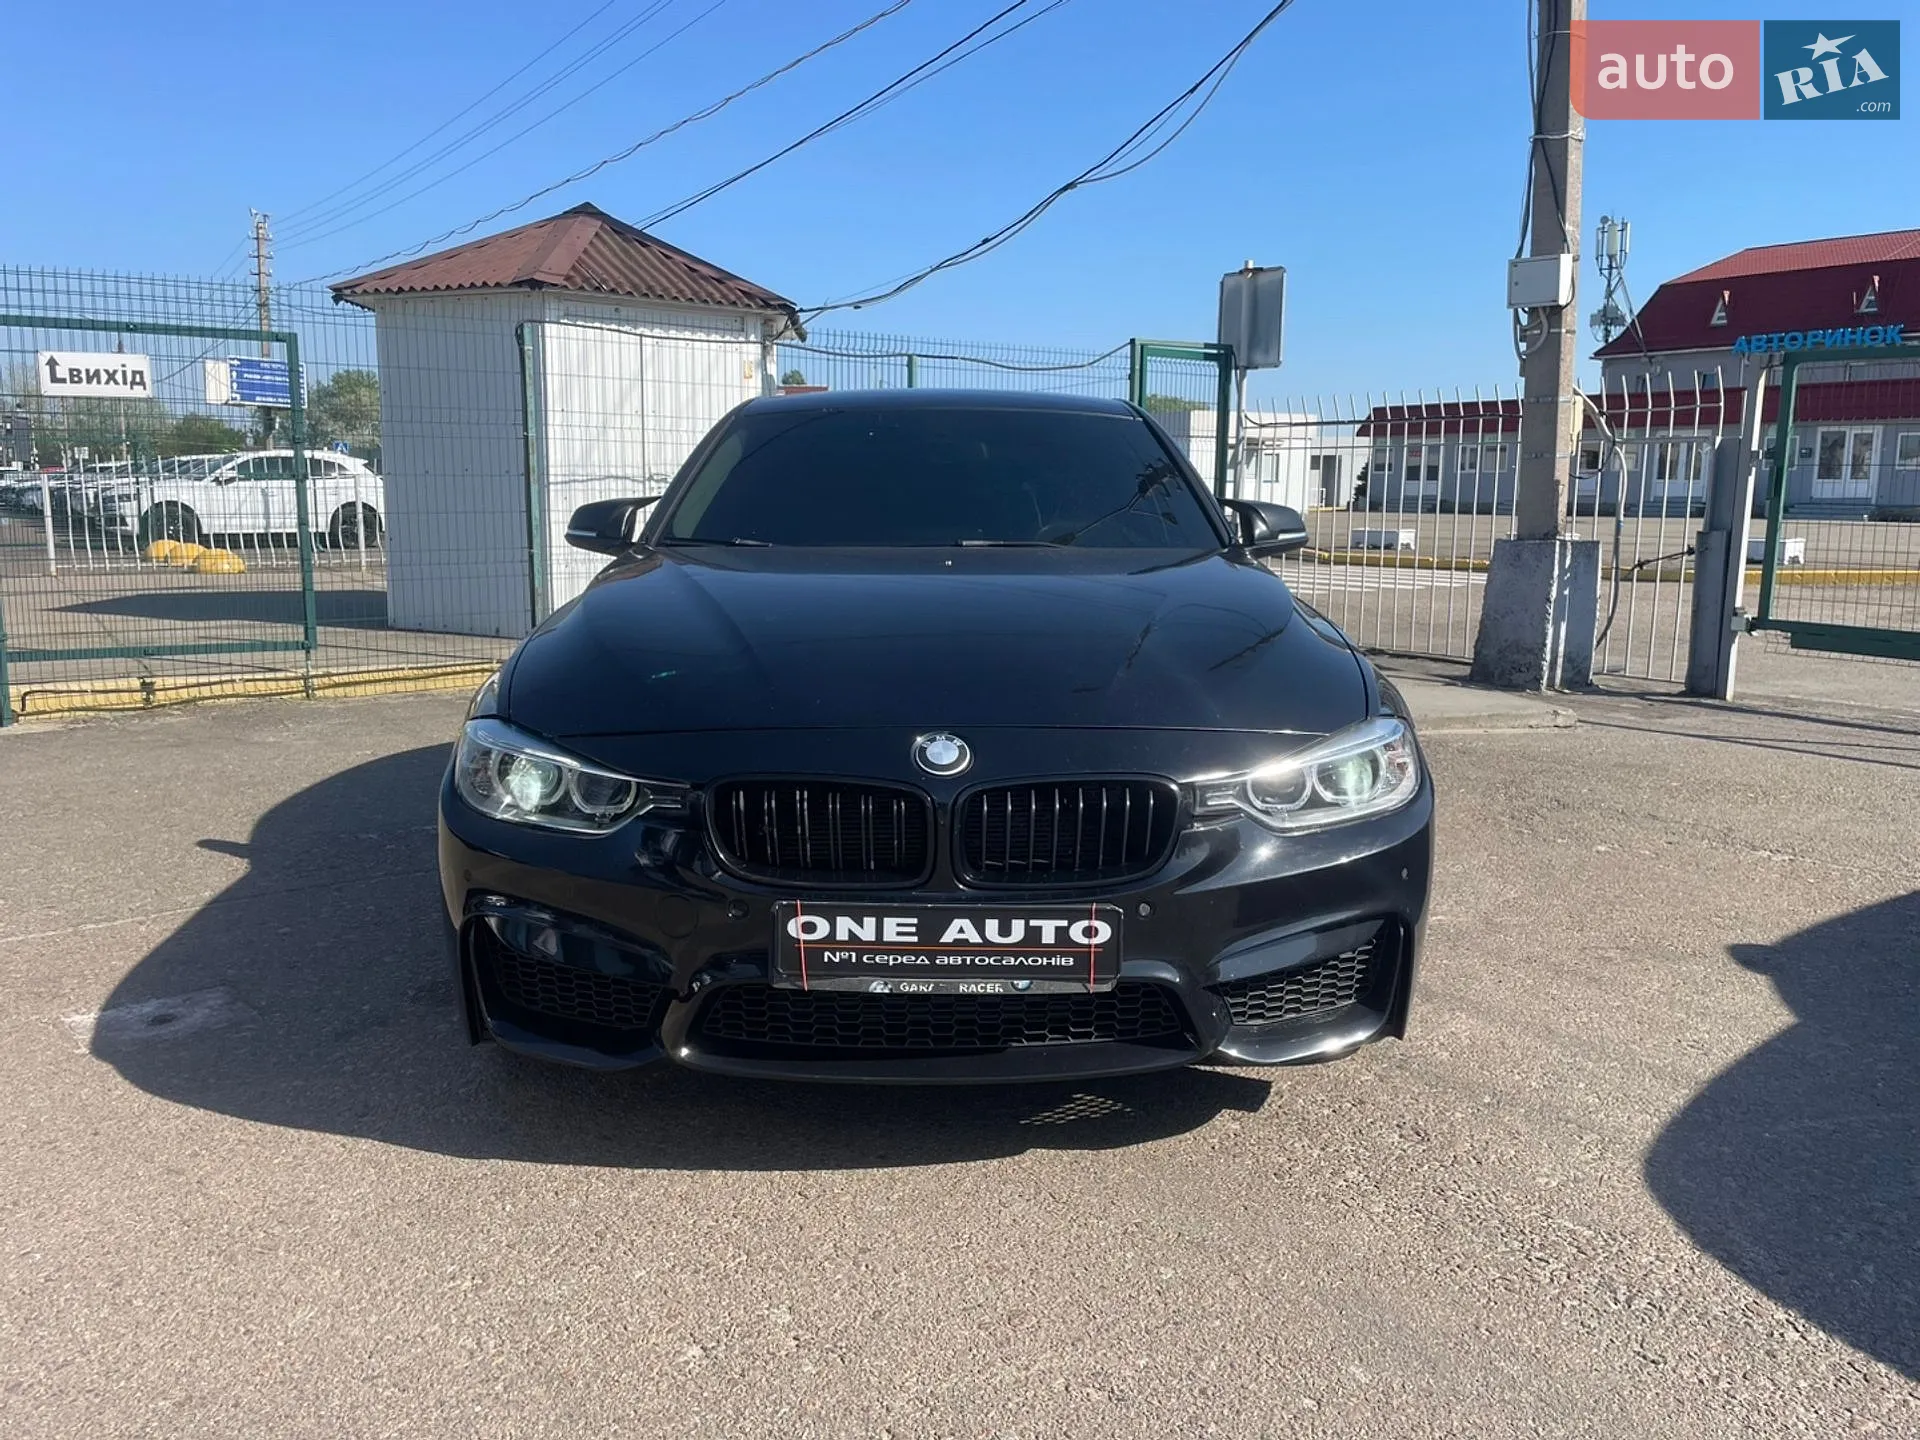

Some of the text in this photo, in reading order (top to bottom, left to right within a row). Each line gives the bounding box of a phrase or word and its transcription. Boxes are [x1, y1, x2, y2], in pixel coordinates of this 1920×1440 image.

[1732, 324, 1905, 354] АВТОРИНОК
[67, 363, 147, 391] вихід
[787, 914, 1112, 945] ONE AUTO
[862, 953, 931, 966] серед
[934, 954, 1075, 967] автосалонів
